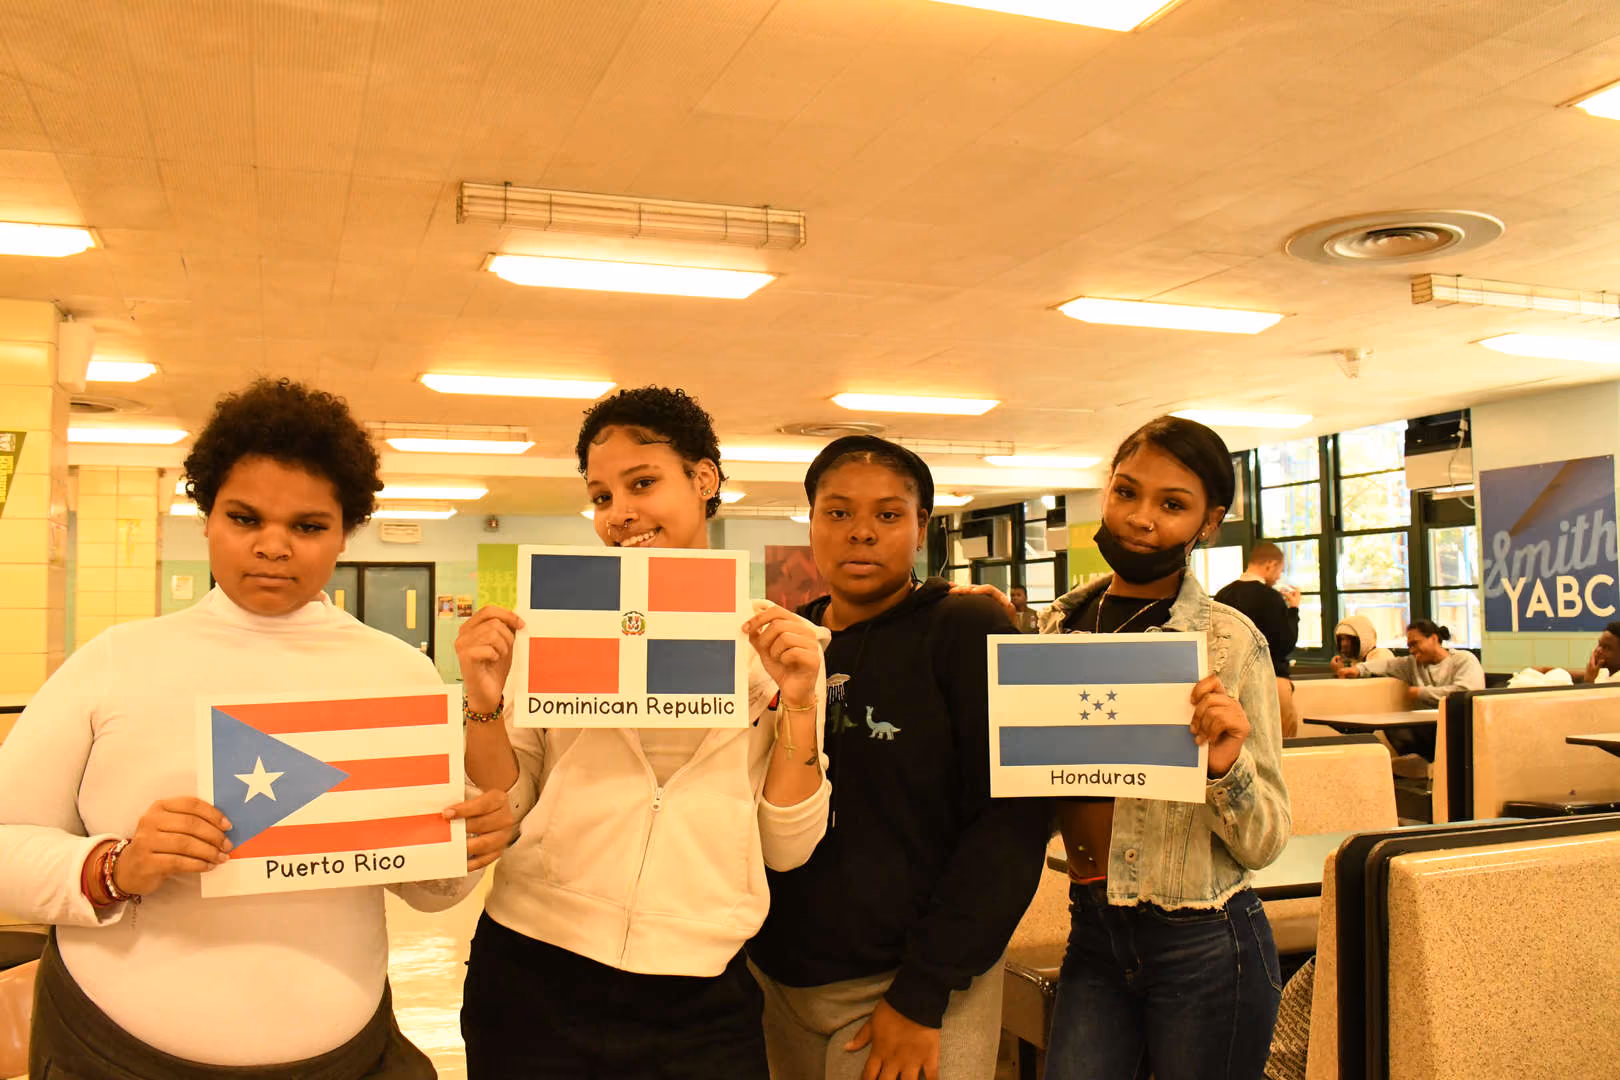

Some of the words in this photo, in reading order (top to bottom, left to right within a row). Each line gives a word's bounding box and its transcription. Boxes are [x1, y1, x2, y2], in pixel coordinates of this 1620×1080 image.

[1483, 509, 1618, 599] Smith
[1501, 574, 1616, 632] YABC
[528, 697, 638, 714] Dominican
[647, 697, 735, 718] Republic
[1051, 769, 1147, 786] Honduras
[266, 856, 345, 879] Puerto
[354, 853, 405, 873] Rico
